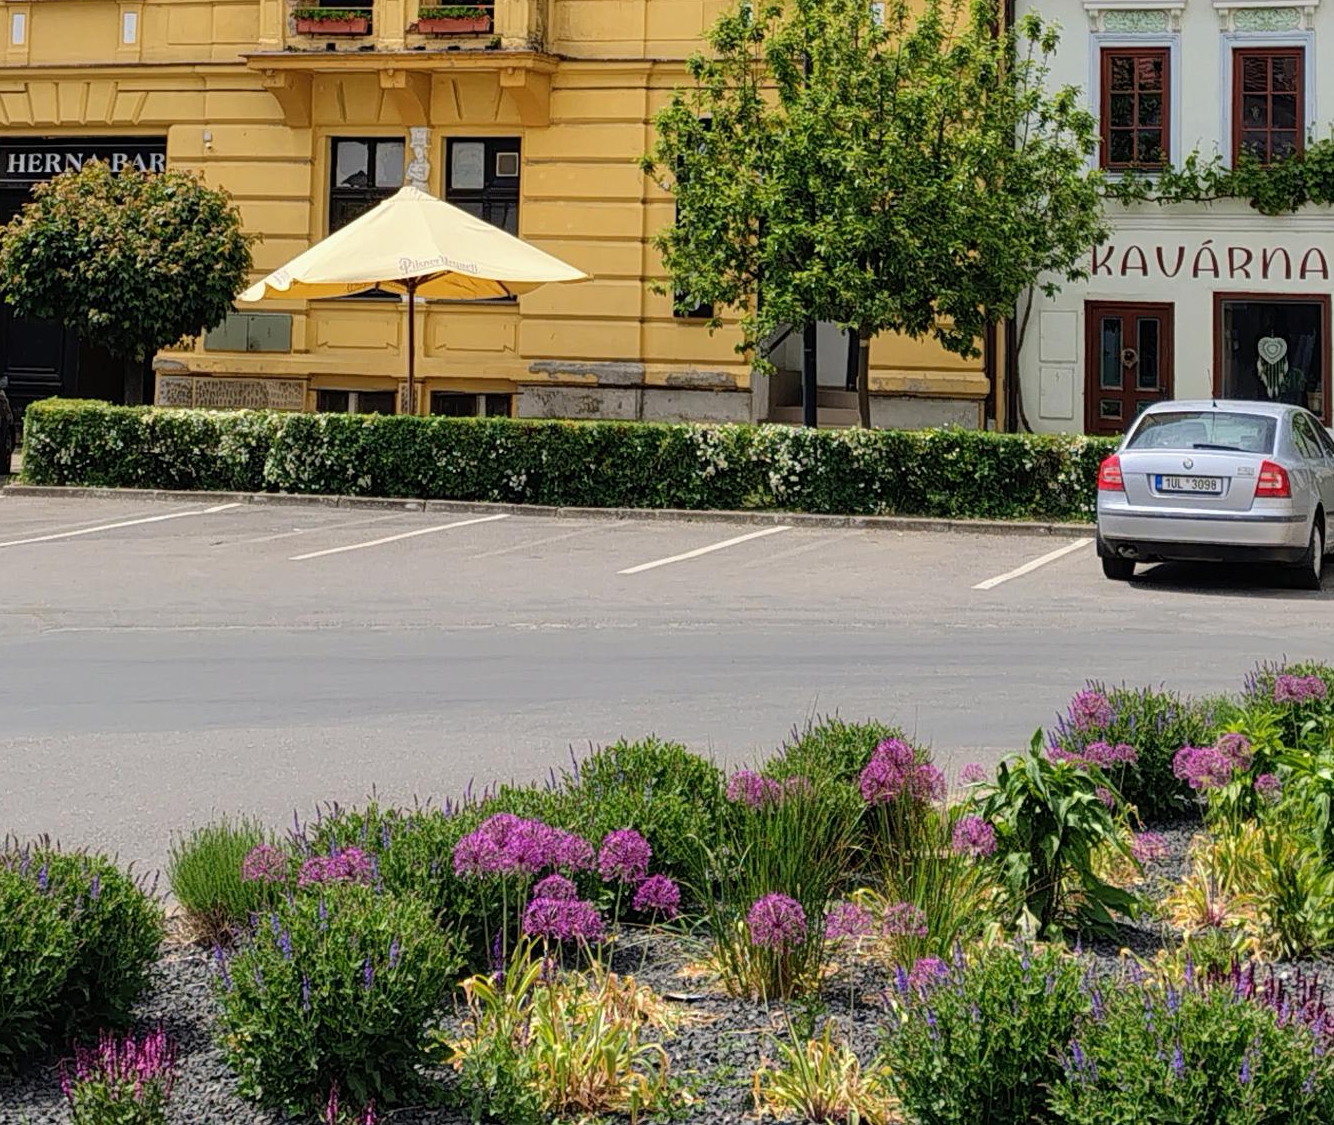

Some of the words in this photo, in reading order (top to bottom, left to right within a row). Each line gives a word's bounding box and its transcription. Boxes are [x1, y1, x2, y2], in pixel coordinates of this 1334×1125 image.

[6, 152, 102, 173] HERN
[111, 152, 165, 174] BAR
[1091, 239, 1329, 280] KAVÁRNA
